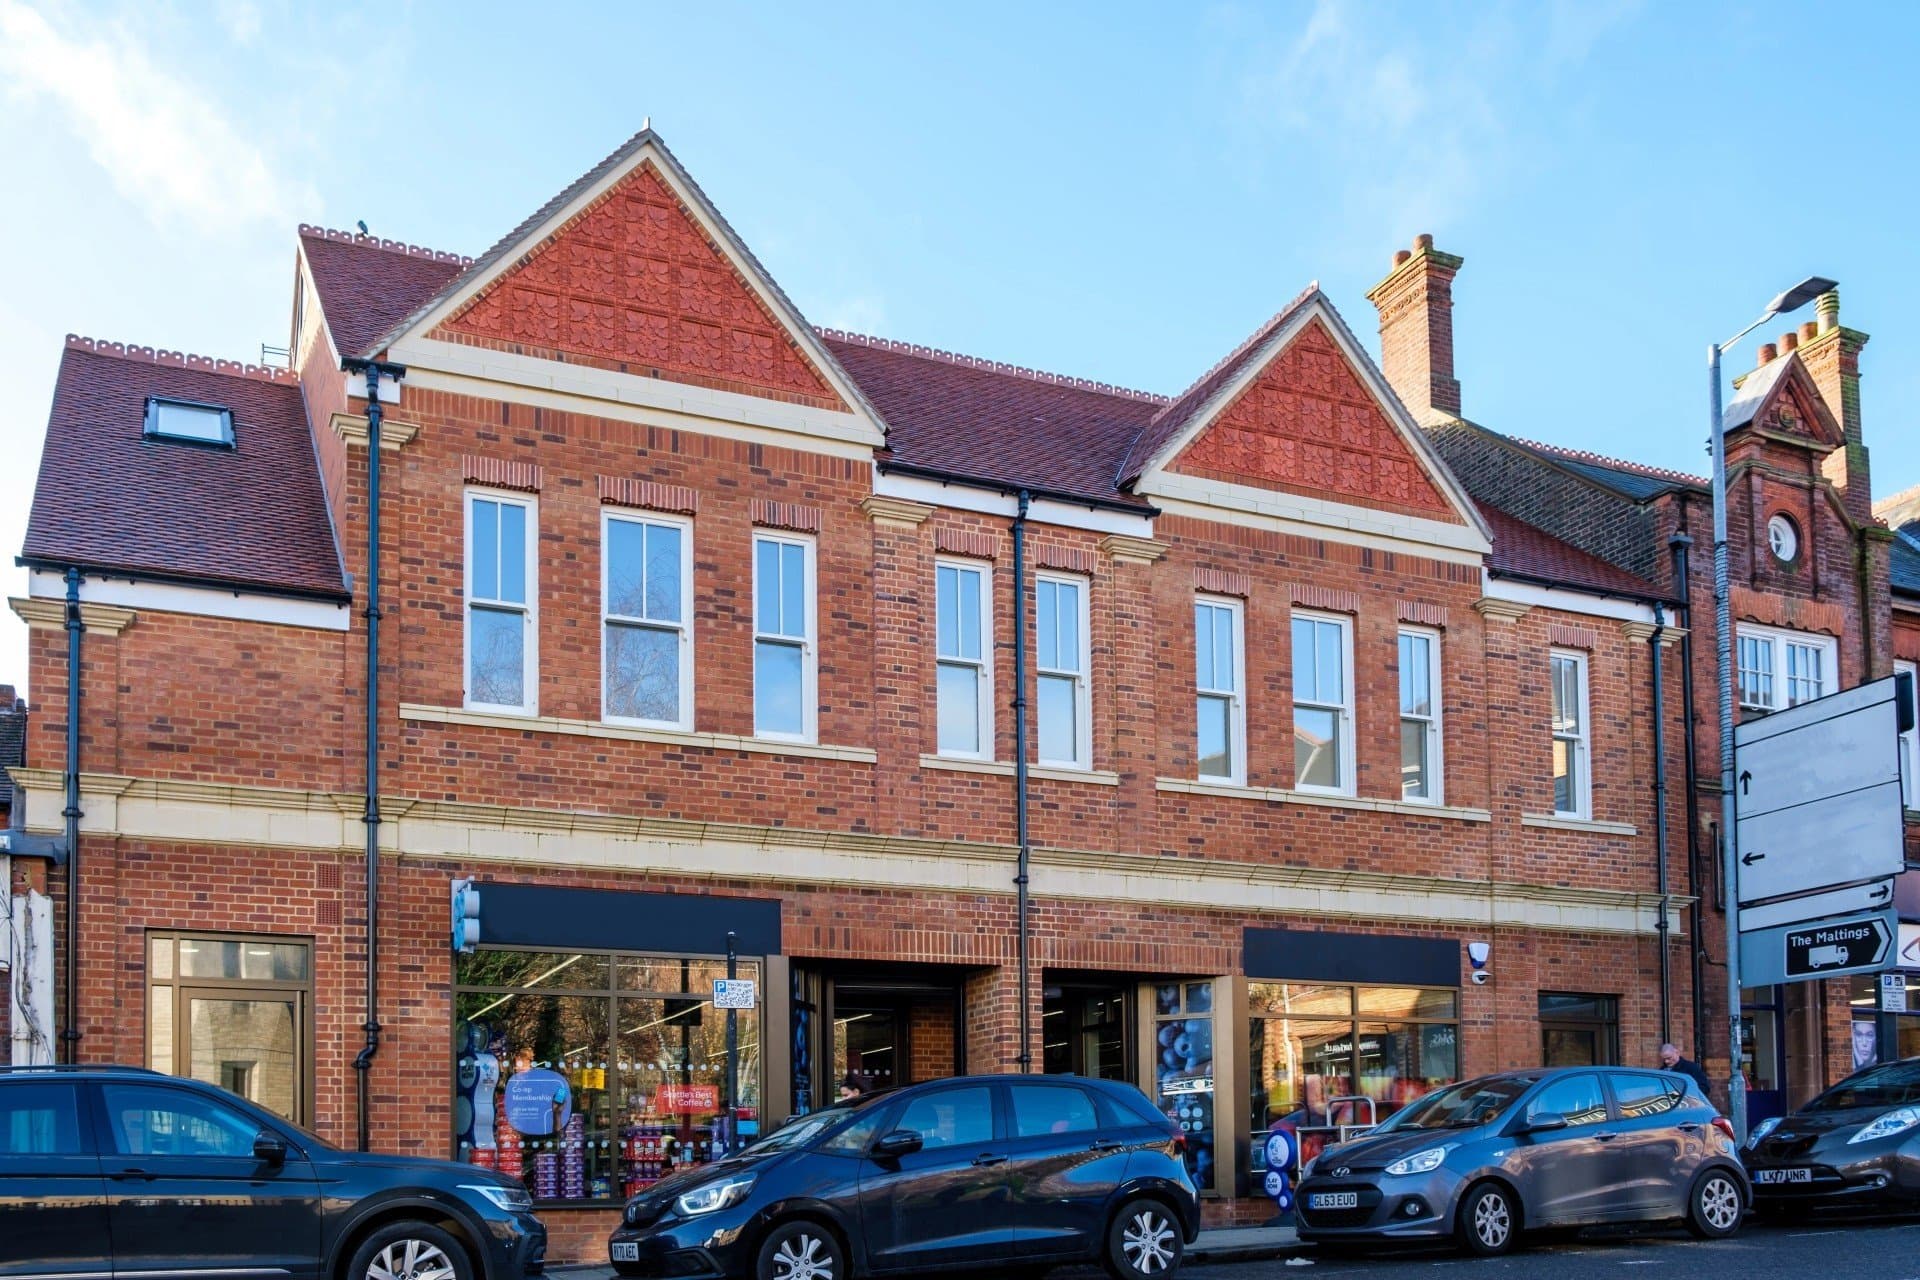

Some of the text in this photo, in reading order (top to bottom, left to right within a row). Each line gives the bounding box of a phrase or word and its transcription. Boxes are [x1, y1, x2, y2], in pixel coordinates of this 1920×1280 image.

[1790, 927, 1870, 948] The Maltings
[717, 982, 726, 992] P
[695, 1091, 713, 1099] Best
[678, 1099, 704, 1107] Coffee
[1337, 1194, 1356, 1206] EUO
